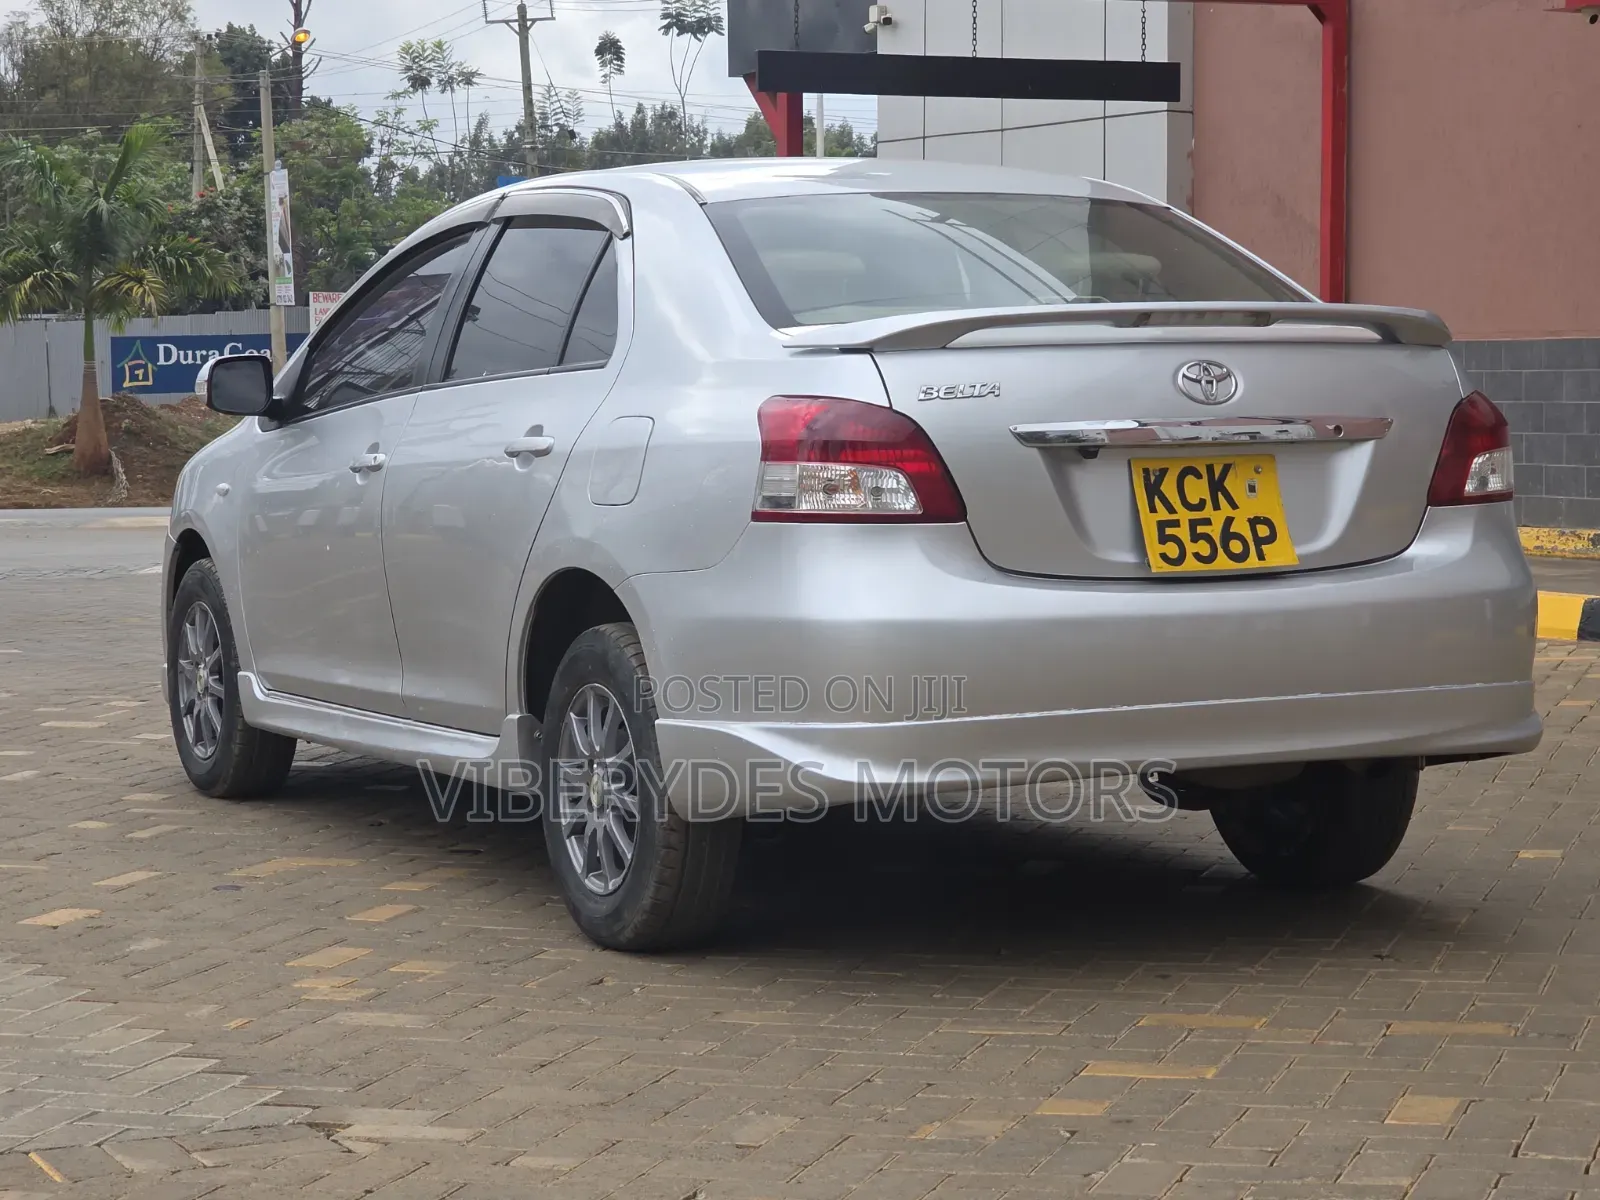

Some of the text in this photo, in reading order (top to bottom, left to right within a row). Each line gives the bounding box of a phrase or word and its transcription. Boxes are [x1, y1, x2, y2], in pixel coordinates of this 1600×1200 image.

[918, 381, 1000, 401] BELTA
[1142, 463, 1240, 514] KCK
[1156, 515, 1278, 567] 556P
